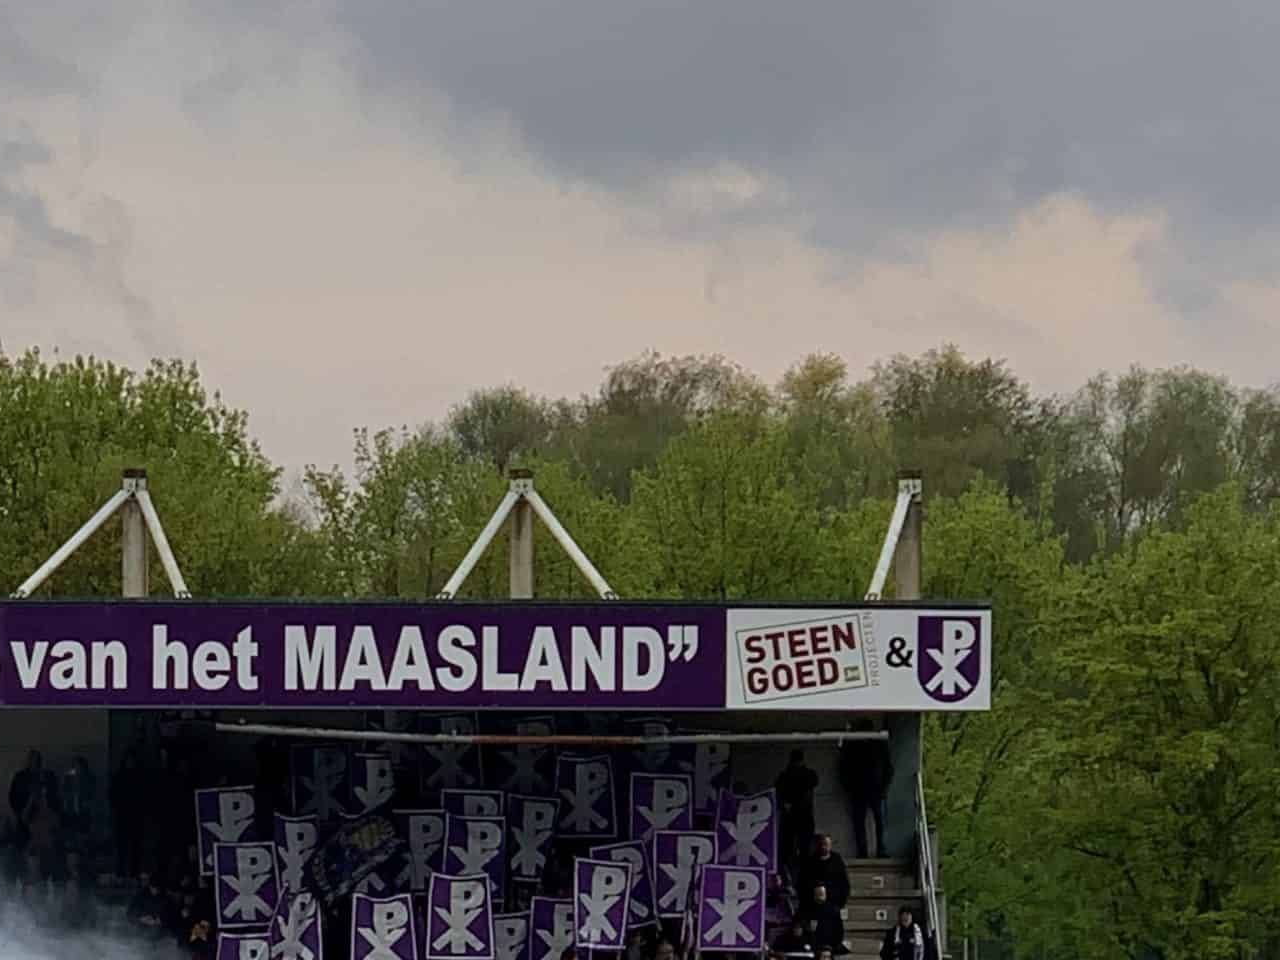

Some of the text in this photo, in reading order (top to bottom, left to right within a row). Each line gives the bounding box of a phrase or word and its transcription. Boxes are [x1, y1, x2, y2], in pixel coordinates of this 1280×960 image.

[11, 640, 129, 691] van
[152, 624, 260, 691] het
[743, 622, 857, 664] STEEN
[885, 636, 915, 669] &
[747, 657, 840, 695] GOED
